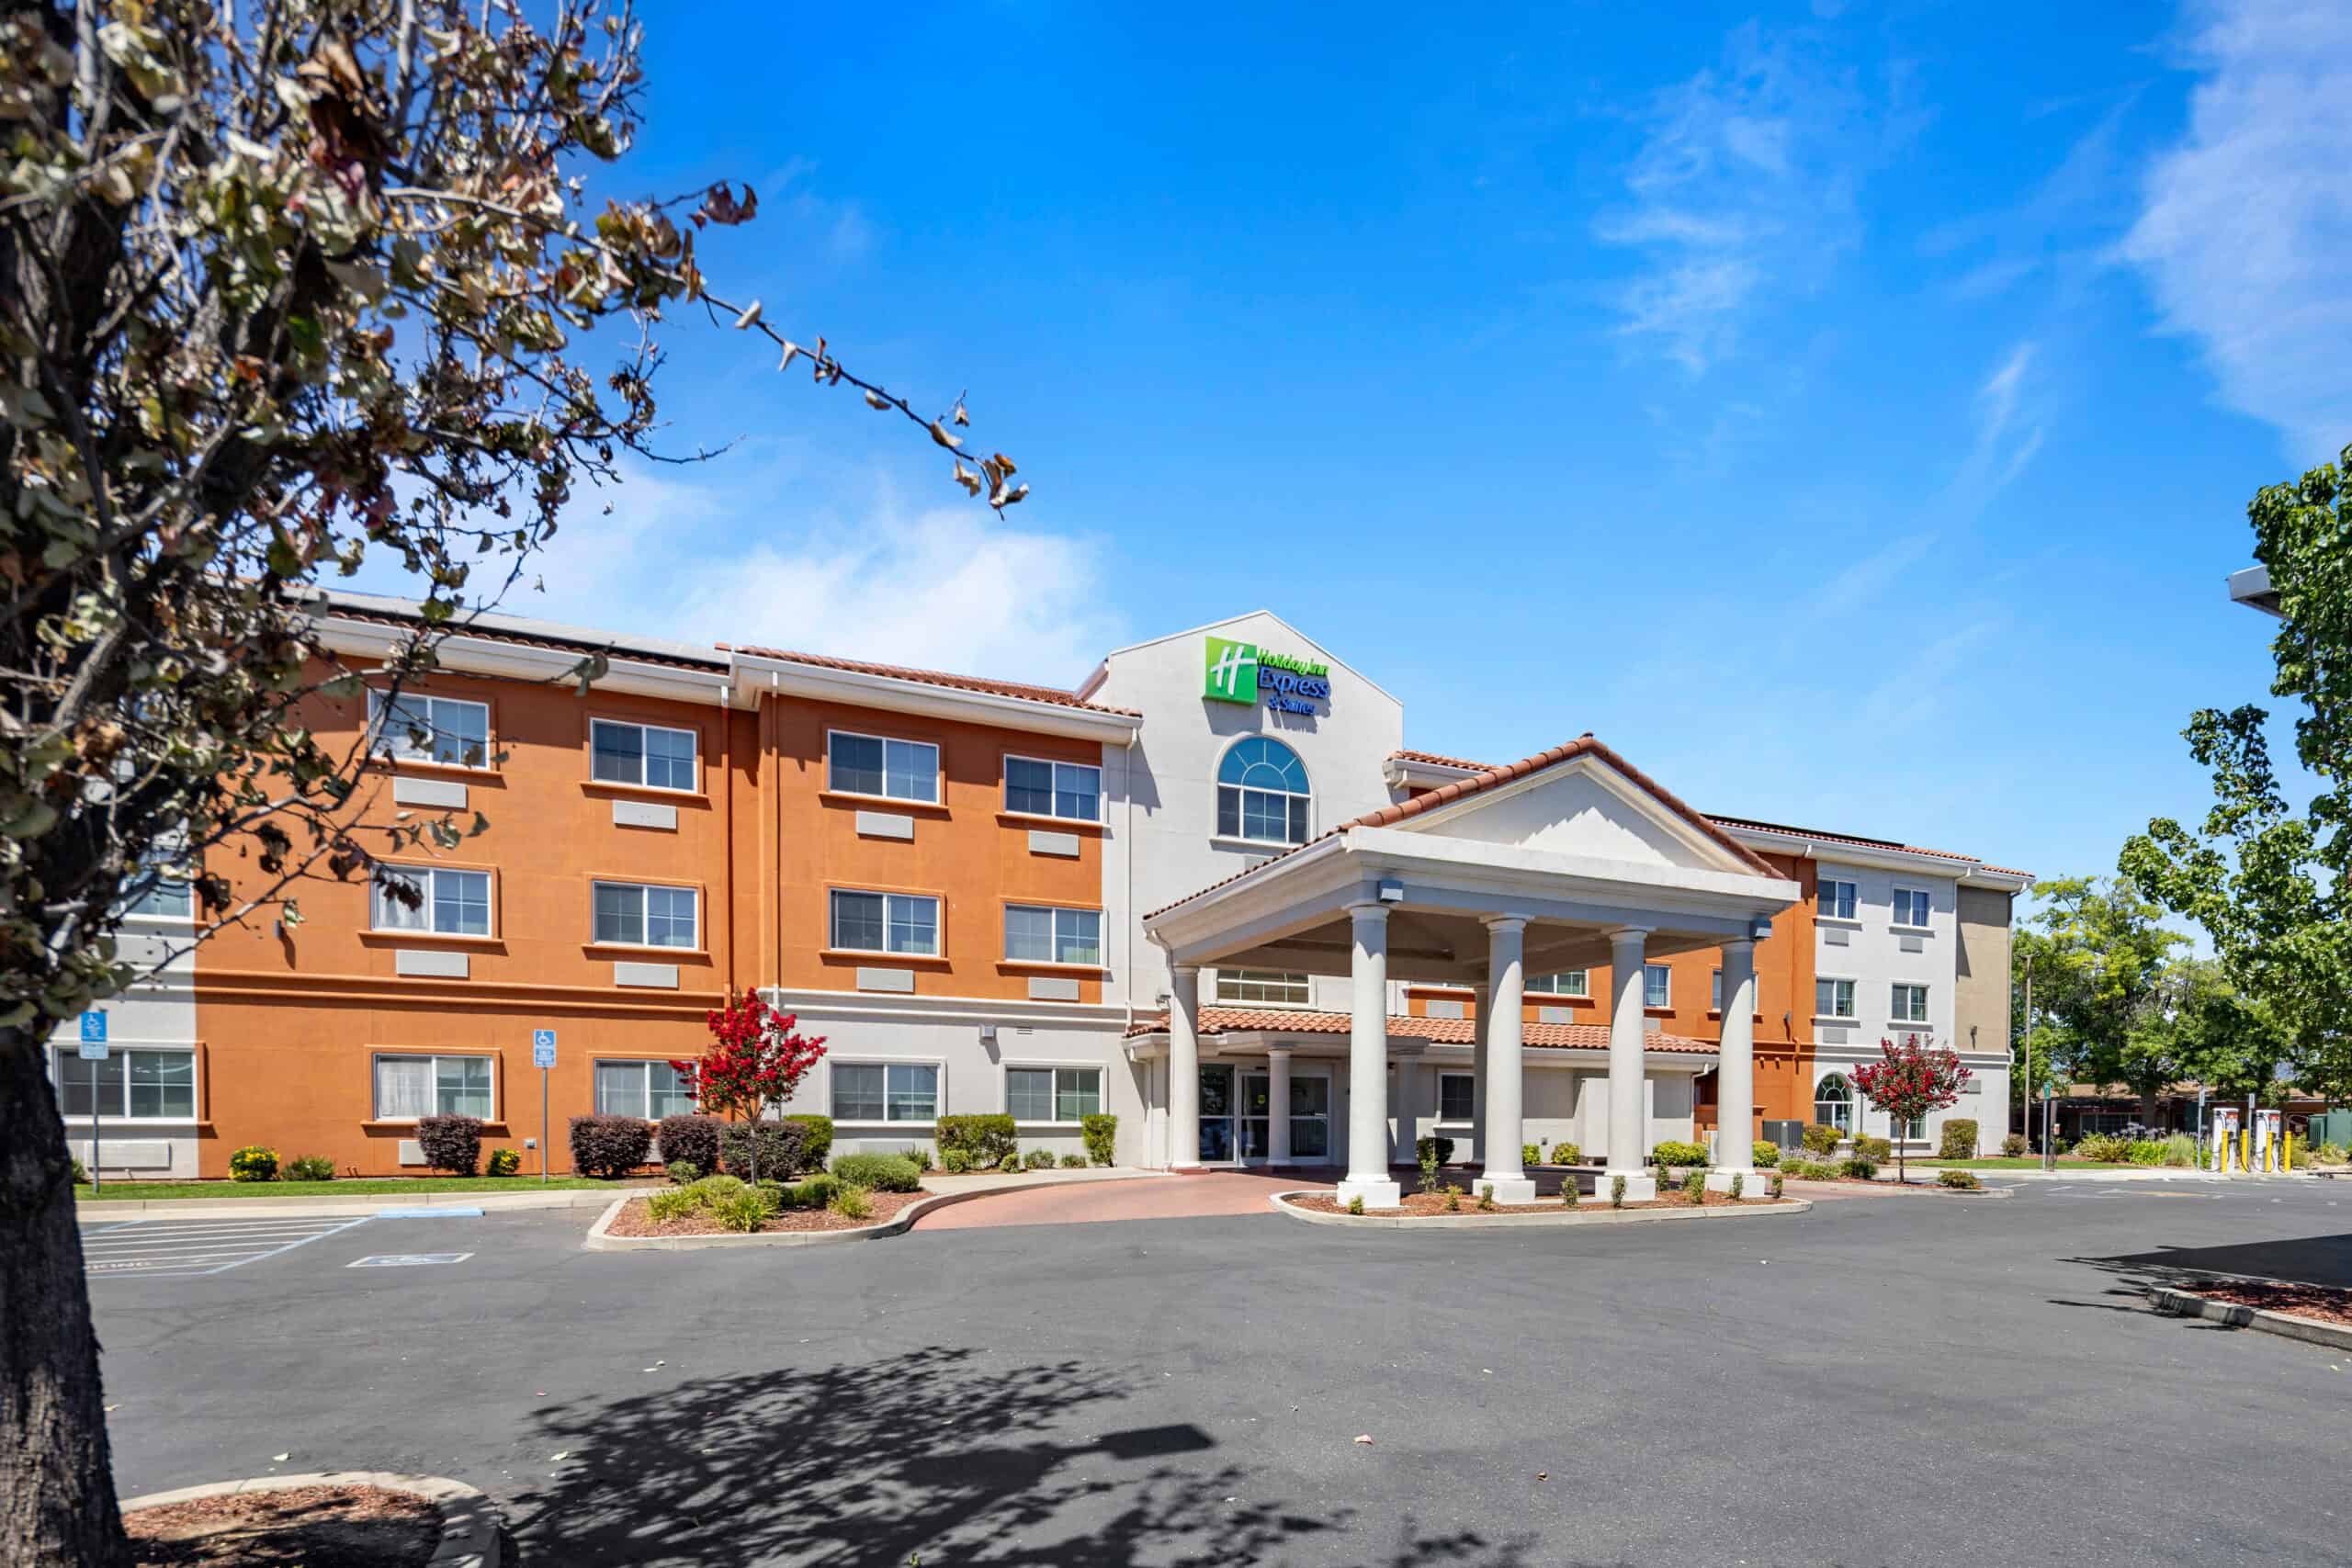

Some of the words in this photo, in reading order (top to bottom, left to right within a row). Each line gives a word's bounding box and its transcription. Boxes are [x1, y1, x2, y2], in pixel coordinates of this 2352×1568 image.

[1258, 648, 1308, 675] Holiday
[1308, 658, 1329, 676] Inn
[1259, 666, 1329, 696] Express
